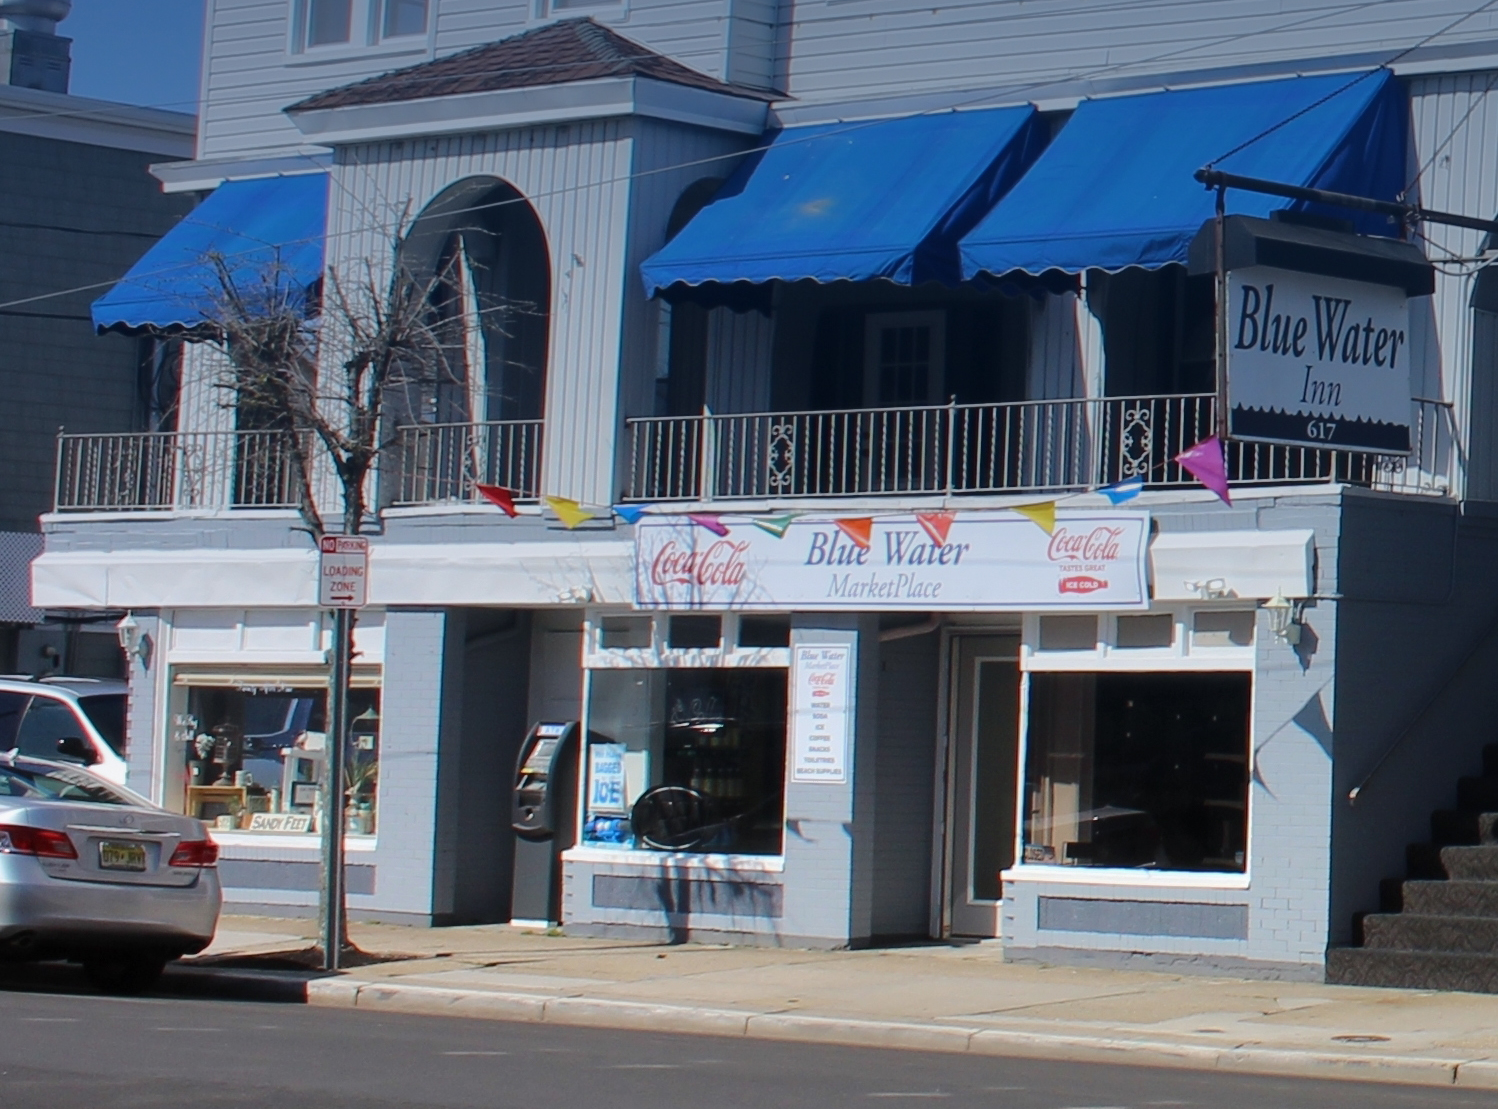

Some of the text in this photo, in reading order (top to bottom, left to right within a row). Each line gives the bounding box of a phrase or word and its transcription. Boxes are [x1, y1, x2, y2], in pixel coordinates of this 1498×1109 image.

[1234, 283, 1405, 370] Blue Water
[1300, 364, 1342, 407] Inn
[1306, 419, 1337, 441] 617
[323, 539, 366, 551] NO PARKING
[804, 529, 970, 566] Blue Water
[1047, 526, 1126, 562] Coca-Cola
[323, 566, 364, 577] LOADING
[652, 540, 753, 586] Coca-Cola
[1059, 564, 1106, 572] TASTES GREAT
[330, 582, 357, 592] ZONE
[827, 571, 943, 599] MarketPlace
[1065, 581, 1099, 589] ICE COLD
[800, 650, 845, 661] Blue Water
[252, 815, 308, 830] SANDY FEET
